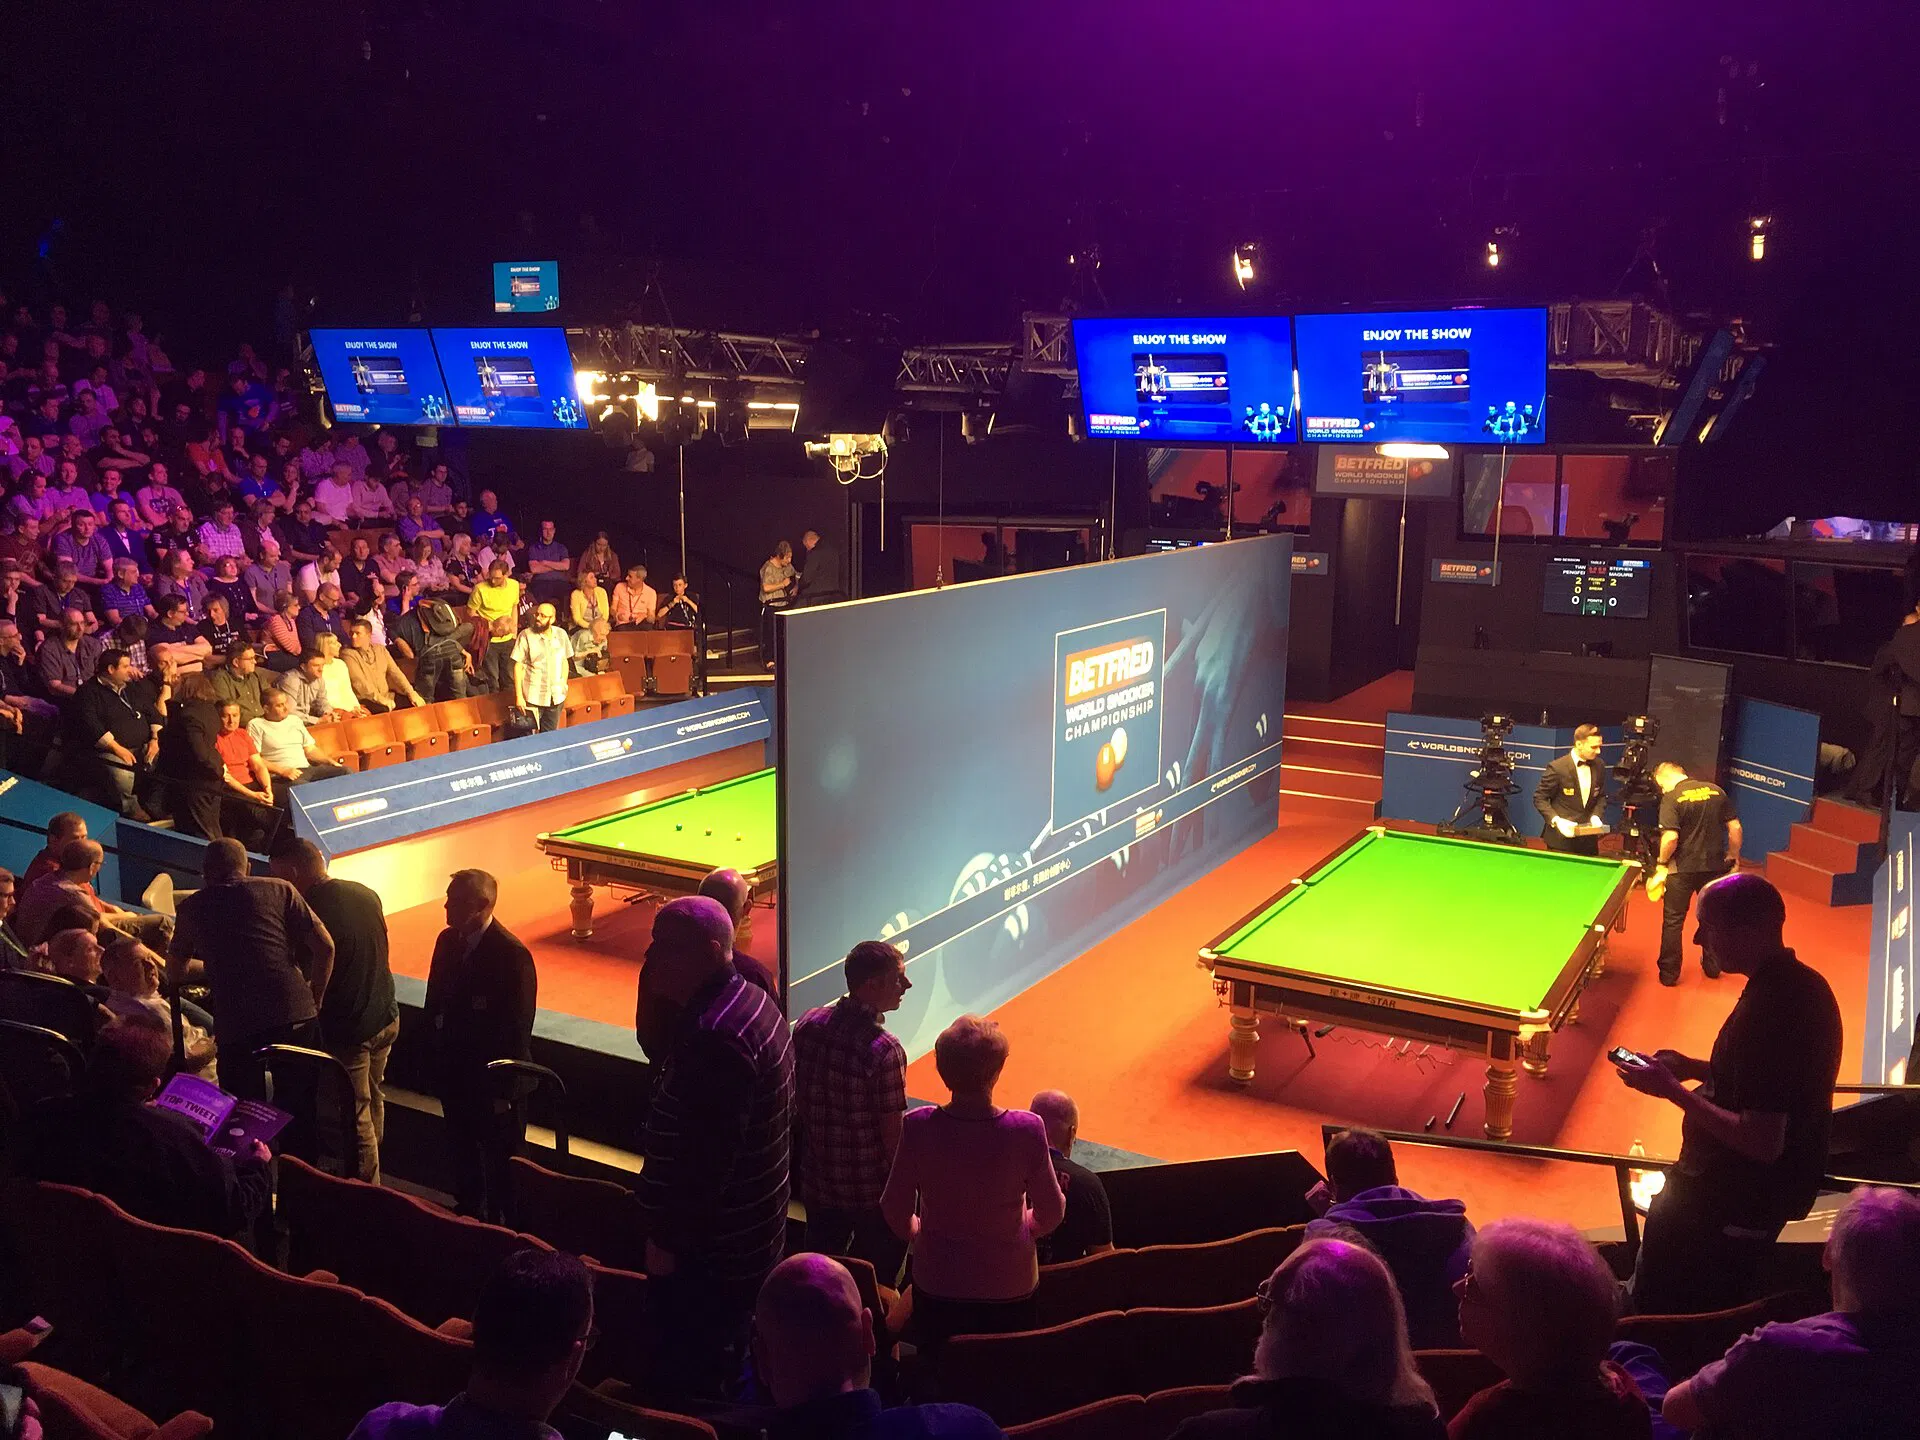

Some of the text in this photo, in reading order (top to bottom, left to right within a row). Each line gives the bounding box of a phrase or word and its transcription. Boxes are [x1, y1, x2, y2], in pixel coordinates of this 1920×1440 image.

[1132, 334, 1227, 344] ENJOY THE SHOW
[1363, 328, 1472, 341] ENJOY THE SHOW
[344, 341, 398, 349] ENJOY THE SHOW
[470, 341, 529, 349] ENJOY THE SHOW
[335, 404, 361, 412] BETFRED
[457, 407, 487, 415] BETFRED
[1091, 415, 1137, 425] BETFRED
[1308, 418, 1360, 428] BETFRED
[1336, 457, 1404, 470] BETFRED
[1440, 564, 1477, 573] BETFRED
[1575, 577, 1582, 585] 2
[1610, 578, 1617, 586] 2
[1574, 586, 1581, 594] 0
[1571, 596, 1580, 605] 0
[1609, 597, 1617, 606] 0
[1068, 641, 1154, 697] BETFRED
[1065, 680, 1155, 724] WORLD SNOOKER
[1065, 699, 1154, 742] CHAMPIONSHIP
[1421, 742, 1531, 760] WORLDSNOCOM
[164, 1094, 220, 1124] TOP TWEETS
